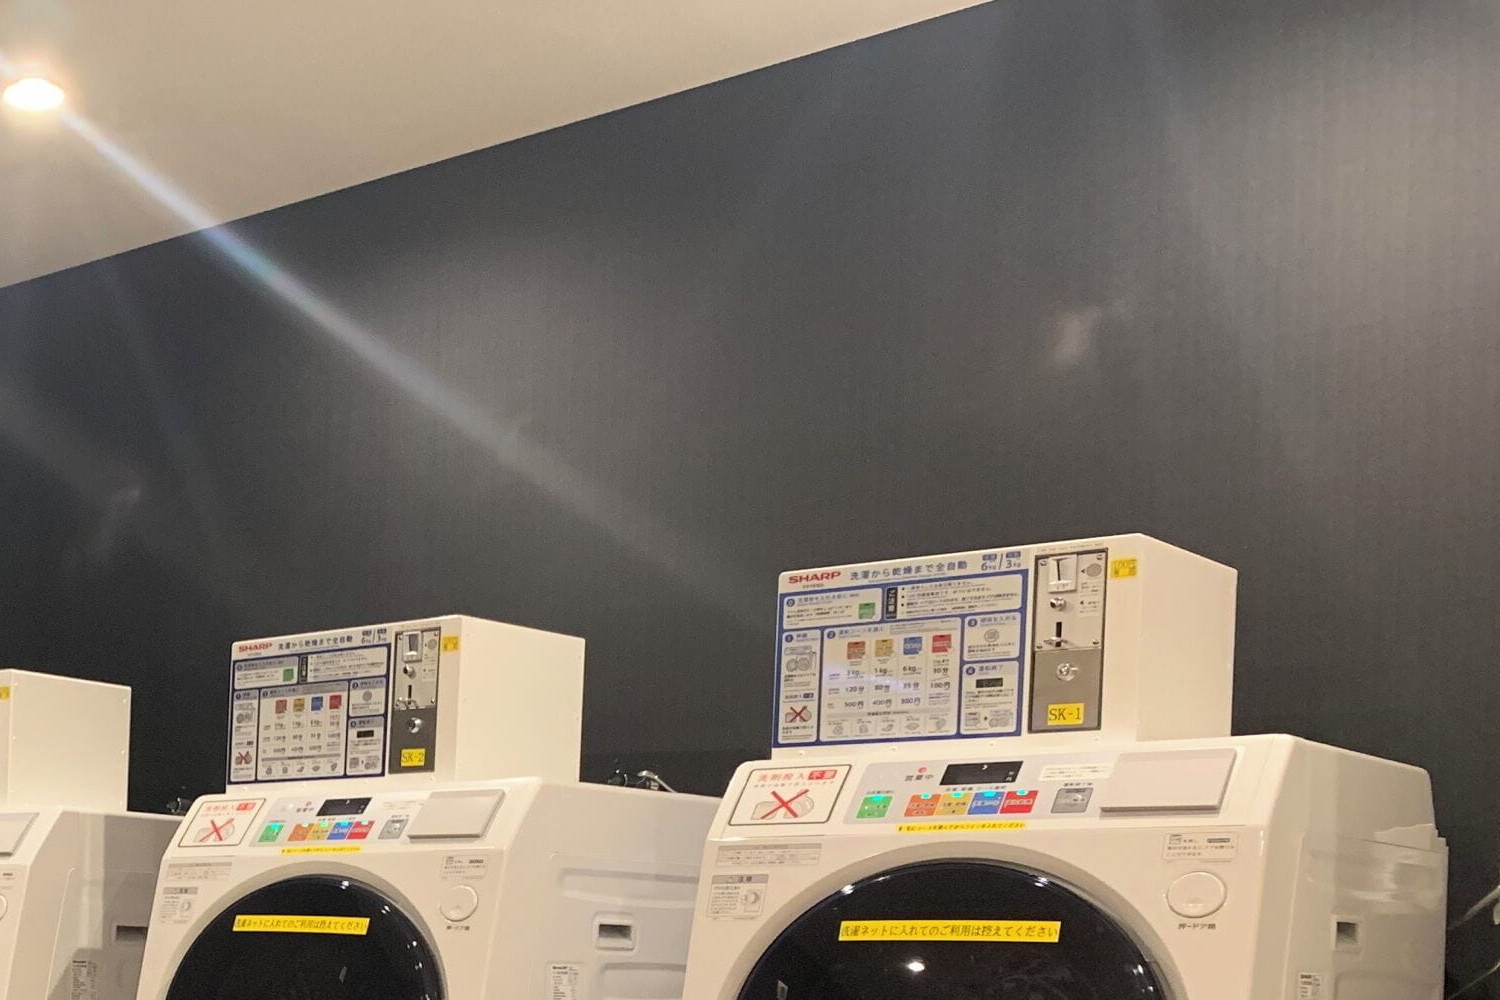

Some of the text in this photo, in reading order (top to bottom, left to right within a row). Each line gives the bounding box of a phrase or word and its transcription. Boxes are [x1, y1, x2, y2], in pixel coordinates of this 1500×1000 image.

[850, 561, 967, 580] 洗濯から乾燥まで全自動
[788, 571, 841, 584] SHARP
[238, 642, 273, 653] SHARP
[1049, 707, 1081, 721] SK-1
[402, 752, 423, 762] SK-2
